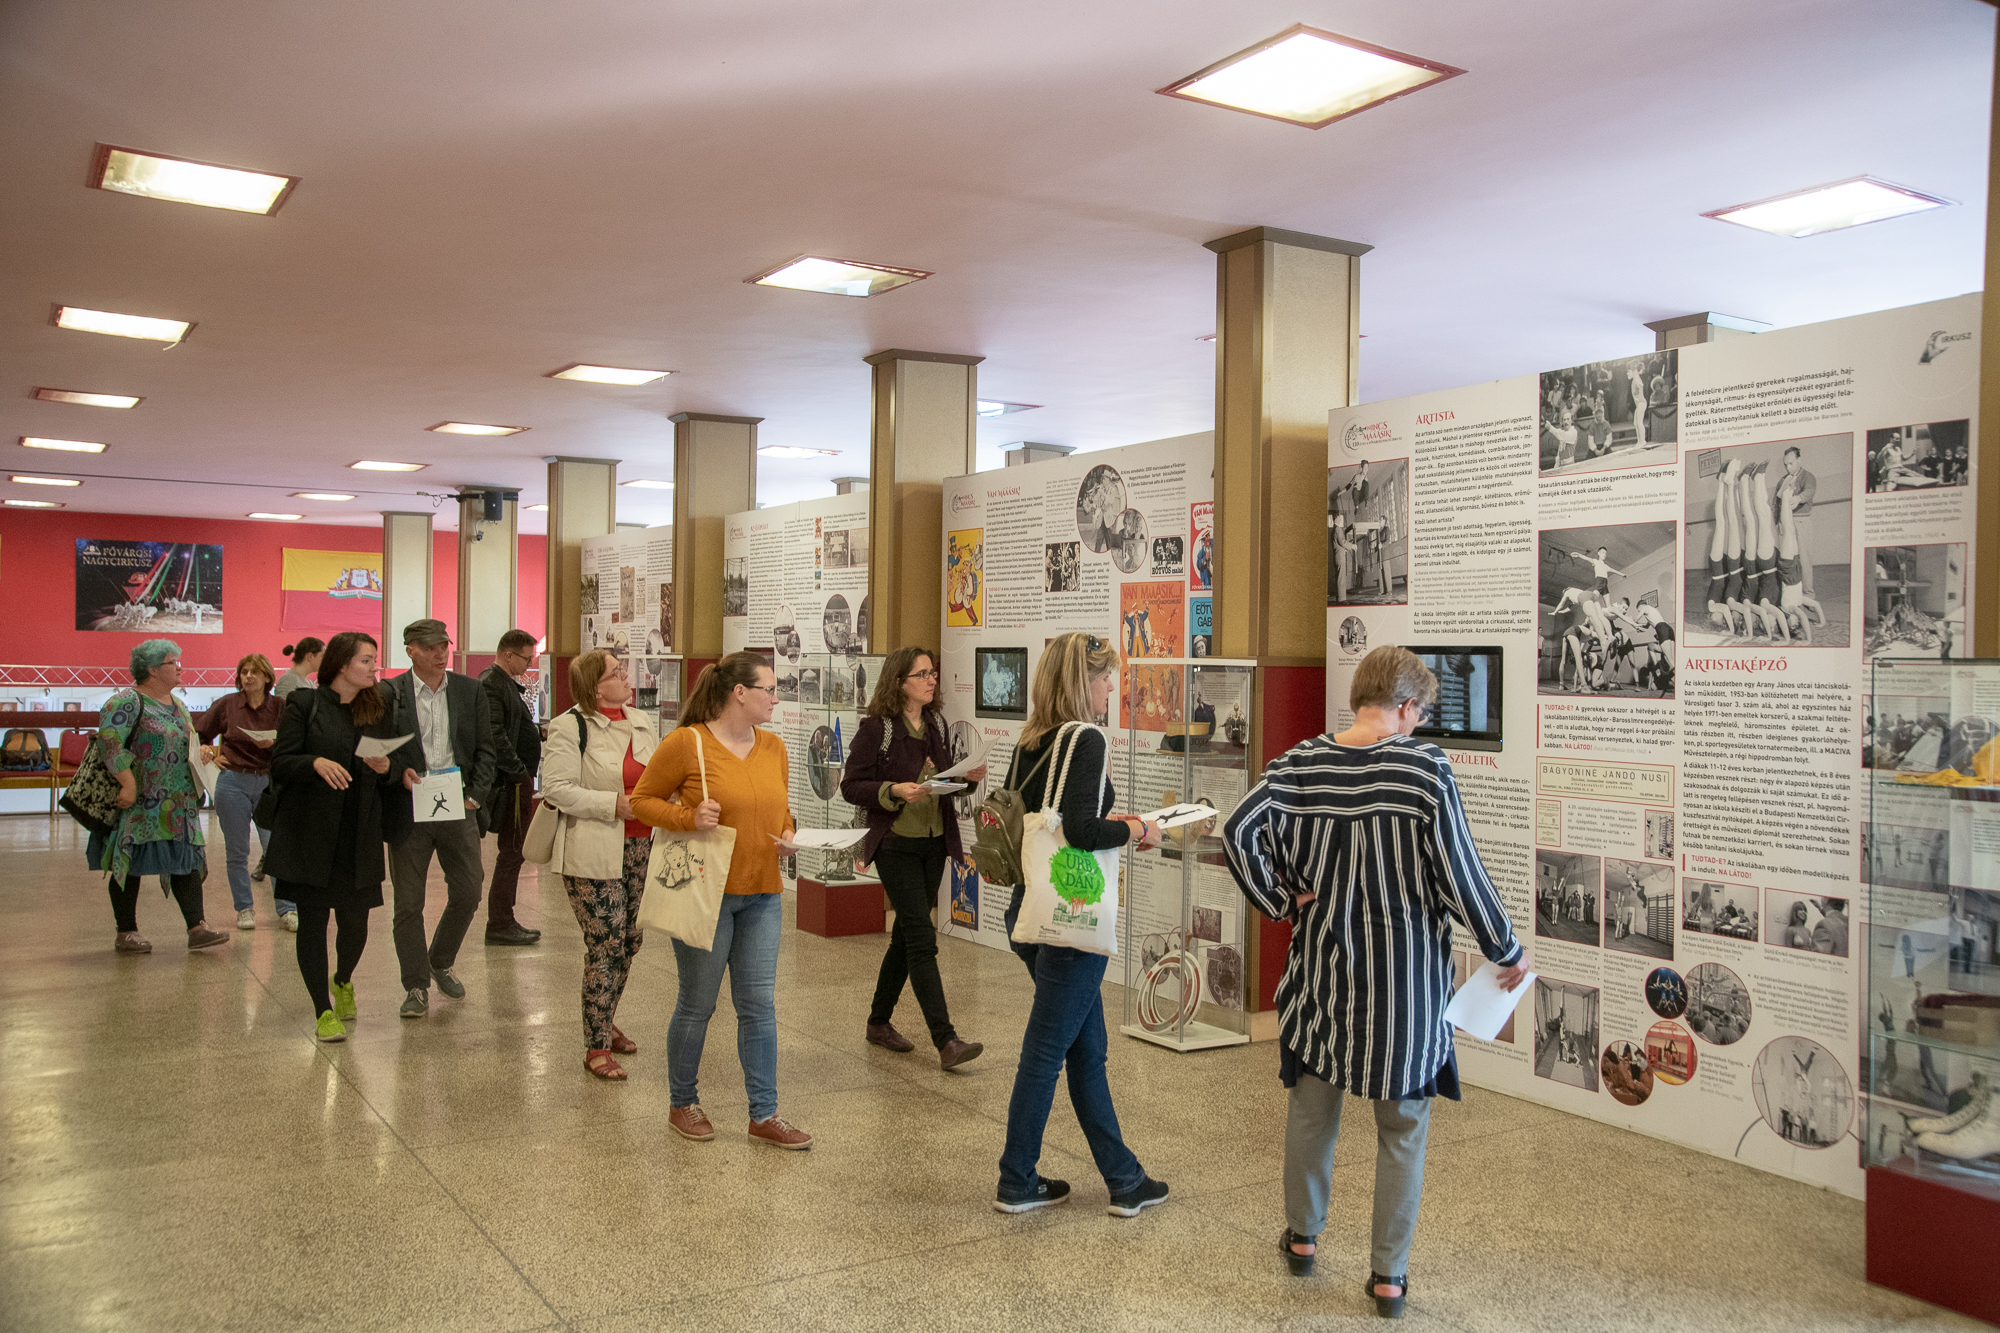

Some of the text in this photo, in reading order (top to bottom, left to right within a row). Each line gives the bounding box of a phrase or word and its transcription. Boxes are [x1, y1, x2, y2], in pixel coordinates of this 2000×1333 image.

[1723, 381, 1755, 394] jelentkező
[1756, 378, 1786, 389] gyerekek
[1815, 380, 1845, 390] egyaránt
[1767, 397, 1792, 407] erőnléti
[1803, 392, 1836, 403] ügyességi
[1416, 410, 1455, 425] ARTISTA
[1685, 419, 1711, 428] datokkal
[1789, 405, 1819, 414] bizottság
[103, 547, 152, 558] FŐVÁROSI
[83, 557, 152, 567] NAGYCIRKUSZ
[1685, 656, 1787, 673] ARTISTAKÉPZŐ
[1766, 734, 1798, 742] ideiglenes
[1450, 753, 1498, 769] SZÜLETIK
[1735, 752, 1747, 761] régi
[1642, 773, 1666, 782] NUSI
[1066, 853, 1092, 872] URB
[1692, 855, 1726, 865] TUDTAD-E?
[1736, 860, 1765, 870] iskolában
[1780, 866, 1801, 875] időben
[1065, 873, 1093, 889] DAN
[1729, 869, 1752, 879] LÁTOD!
